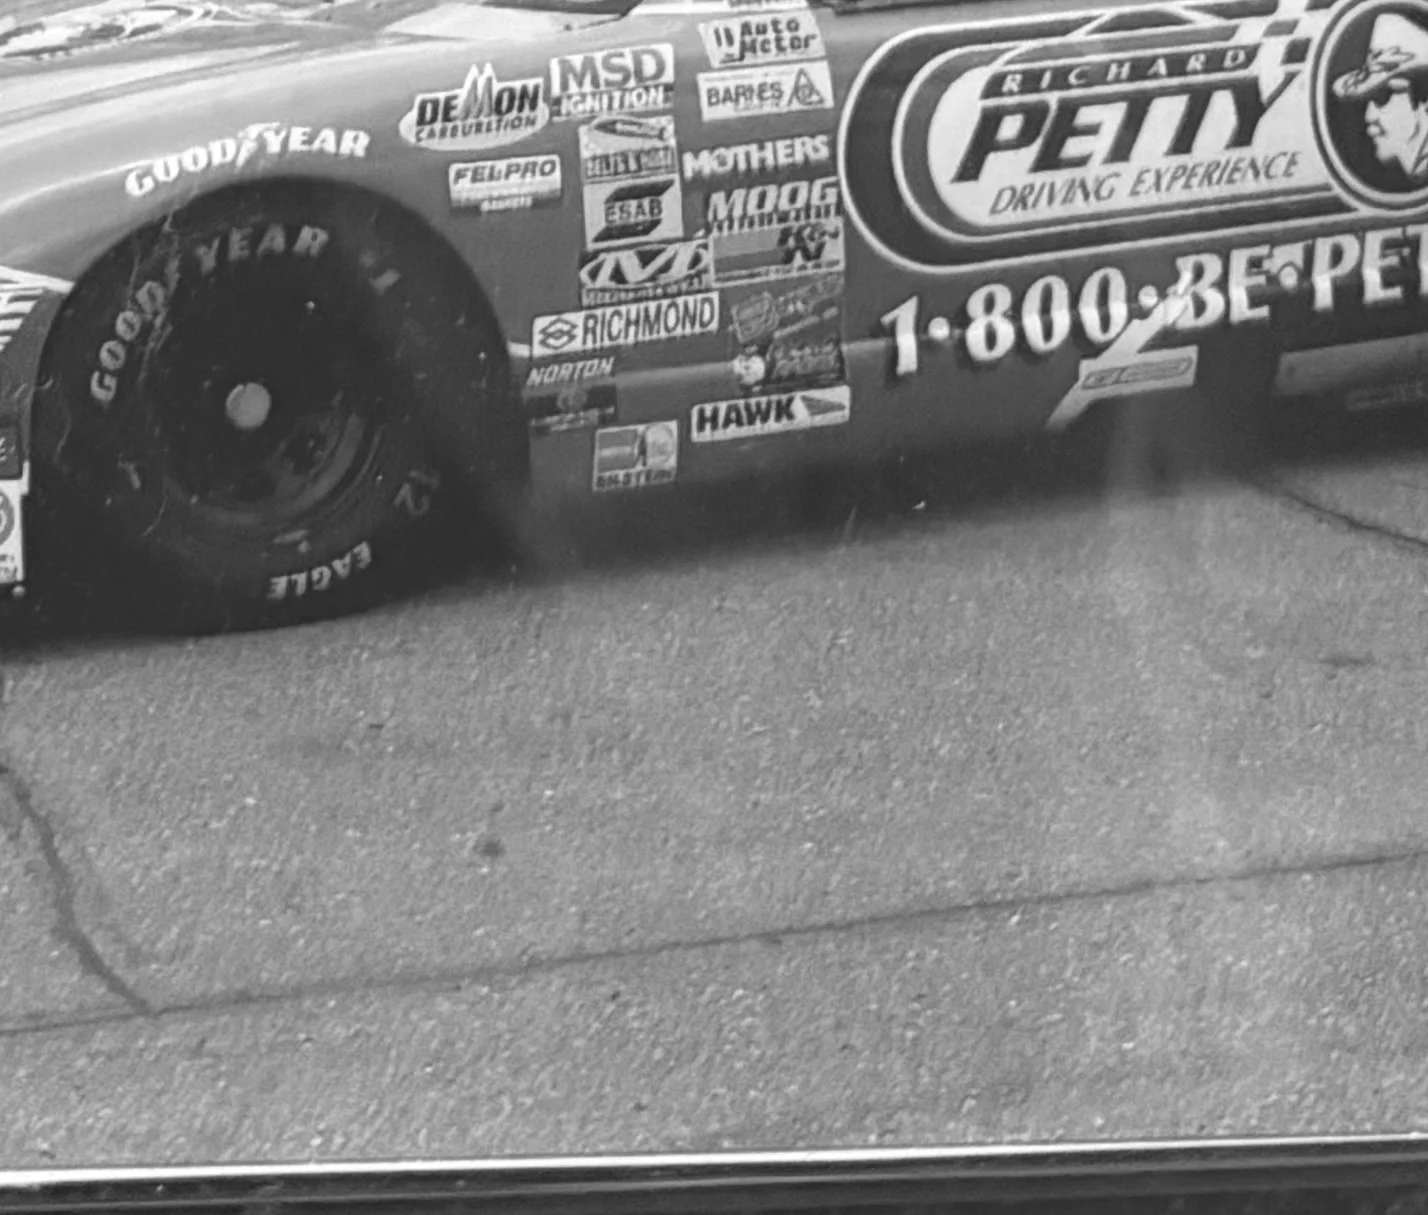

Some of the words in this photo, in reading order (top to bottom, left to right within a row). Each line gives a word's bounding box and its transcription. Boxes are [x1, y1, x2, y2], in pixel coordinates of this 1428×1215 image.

[740, 18, 800, 37] Auto
[557, 48, 666, 94] MSD
[1002, 47, 1258, 95] RICHARD
[416, 74, 541, 128] DEMON
[560, 84, 665, 117] IGNITION
[950, 71, 1301, 183] PETTY
[683, 134, 830, 181] MOTHERS
[707, 176, 840, 222] MOOG
[988, 170, 1117, 216] DRIVING
[1128, 150, 1300, 197] EXPERIENCE
[605, 197, 663, 226] ESAB
[581, 295, 716, 347] RICHMOND
[526, 356, 615, 386] NORTON
[696, 395, 796, 434] HAWK
[267, 541, 373, 599] EAGLE
